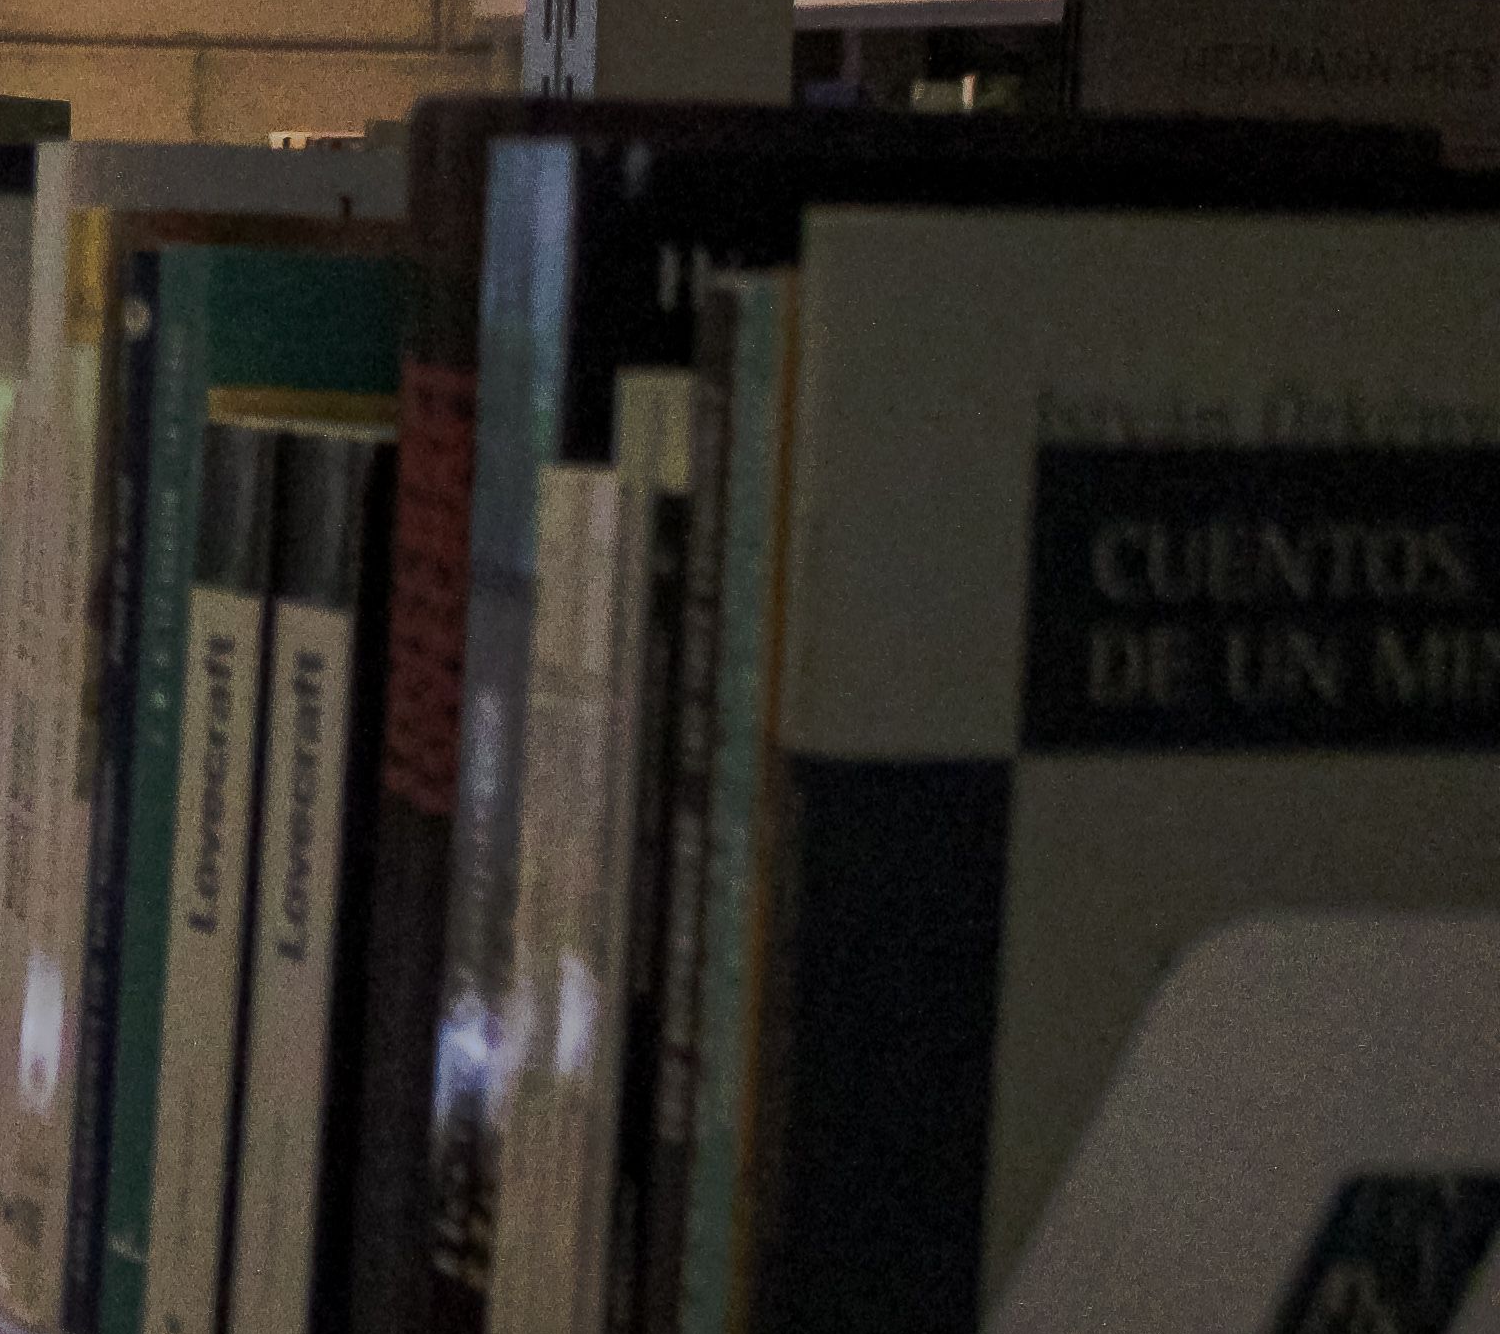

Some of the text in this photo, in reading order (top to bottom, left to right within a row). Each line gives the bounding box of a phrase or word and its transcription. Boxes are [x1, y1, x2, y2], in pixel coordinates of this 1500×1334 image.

[1092, 521, 1475, 603] CUENTOS
[1090, 624, 1189, 704] DE
[1225, 626, 1344, 703] UN
[187, 634, 234, 934] Lovecraft
[276, 651, 324, 961] Lovecraft
